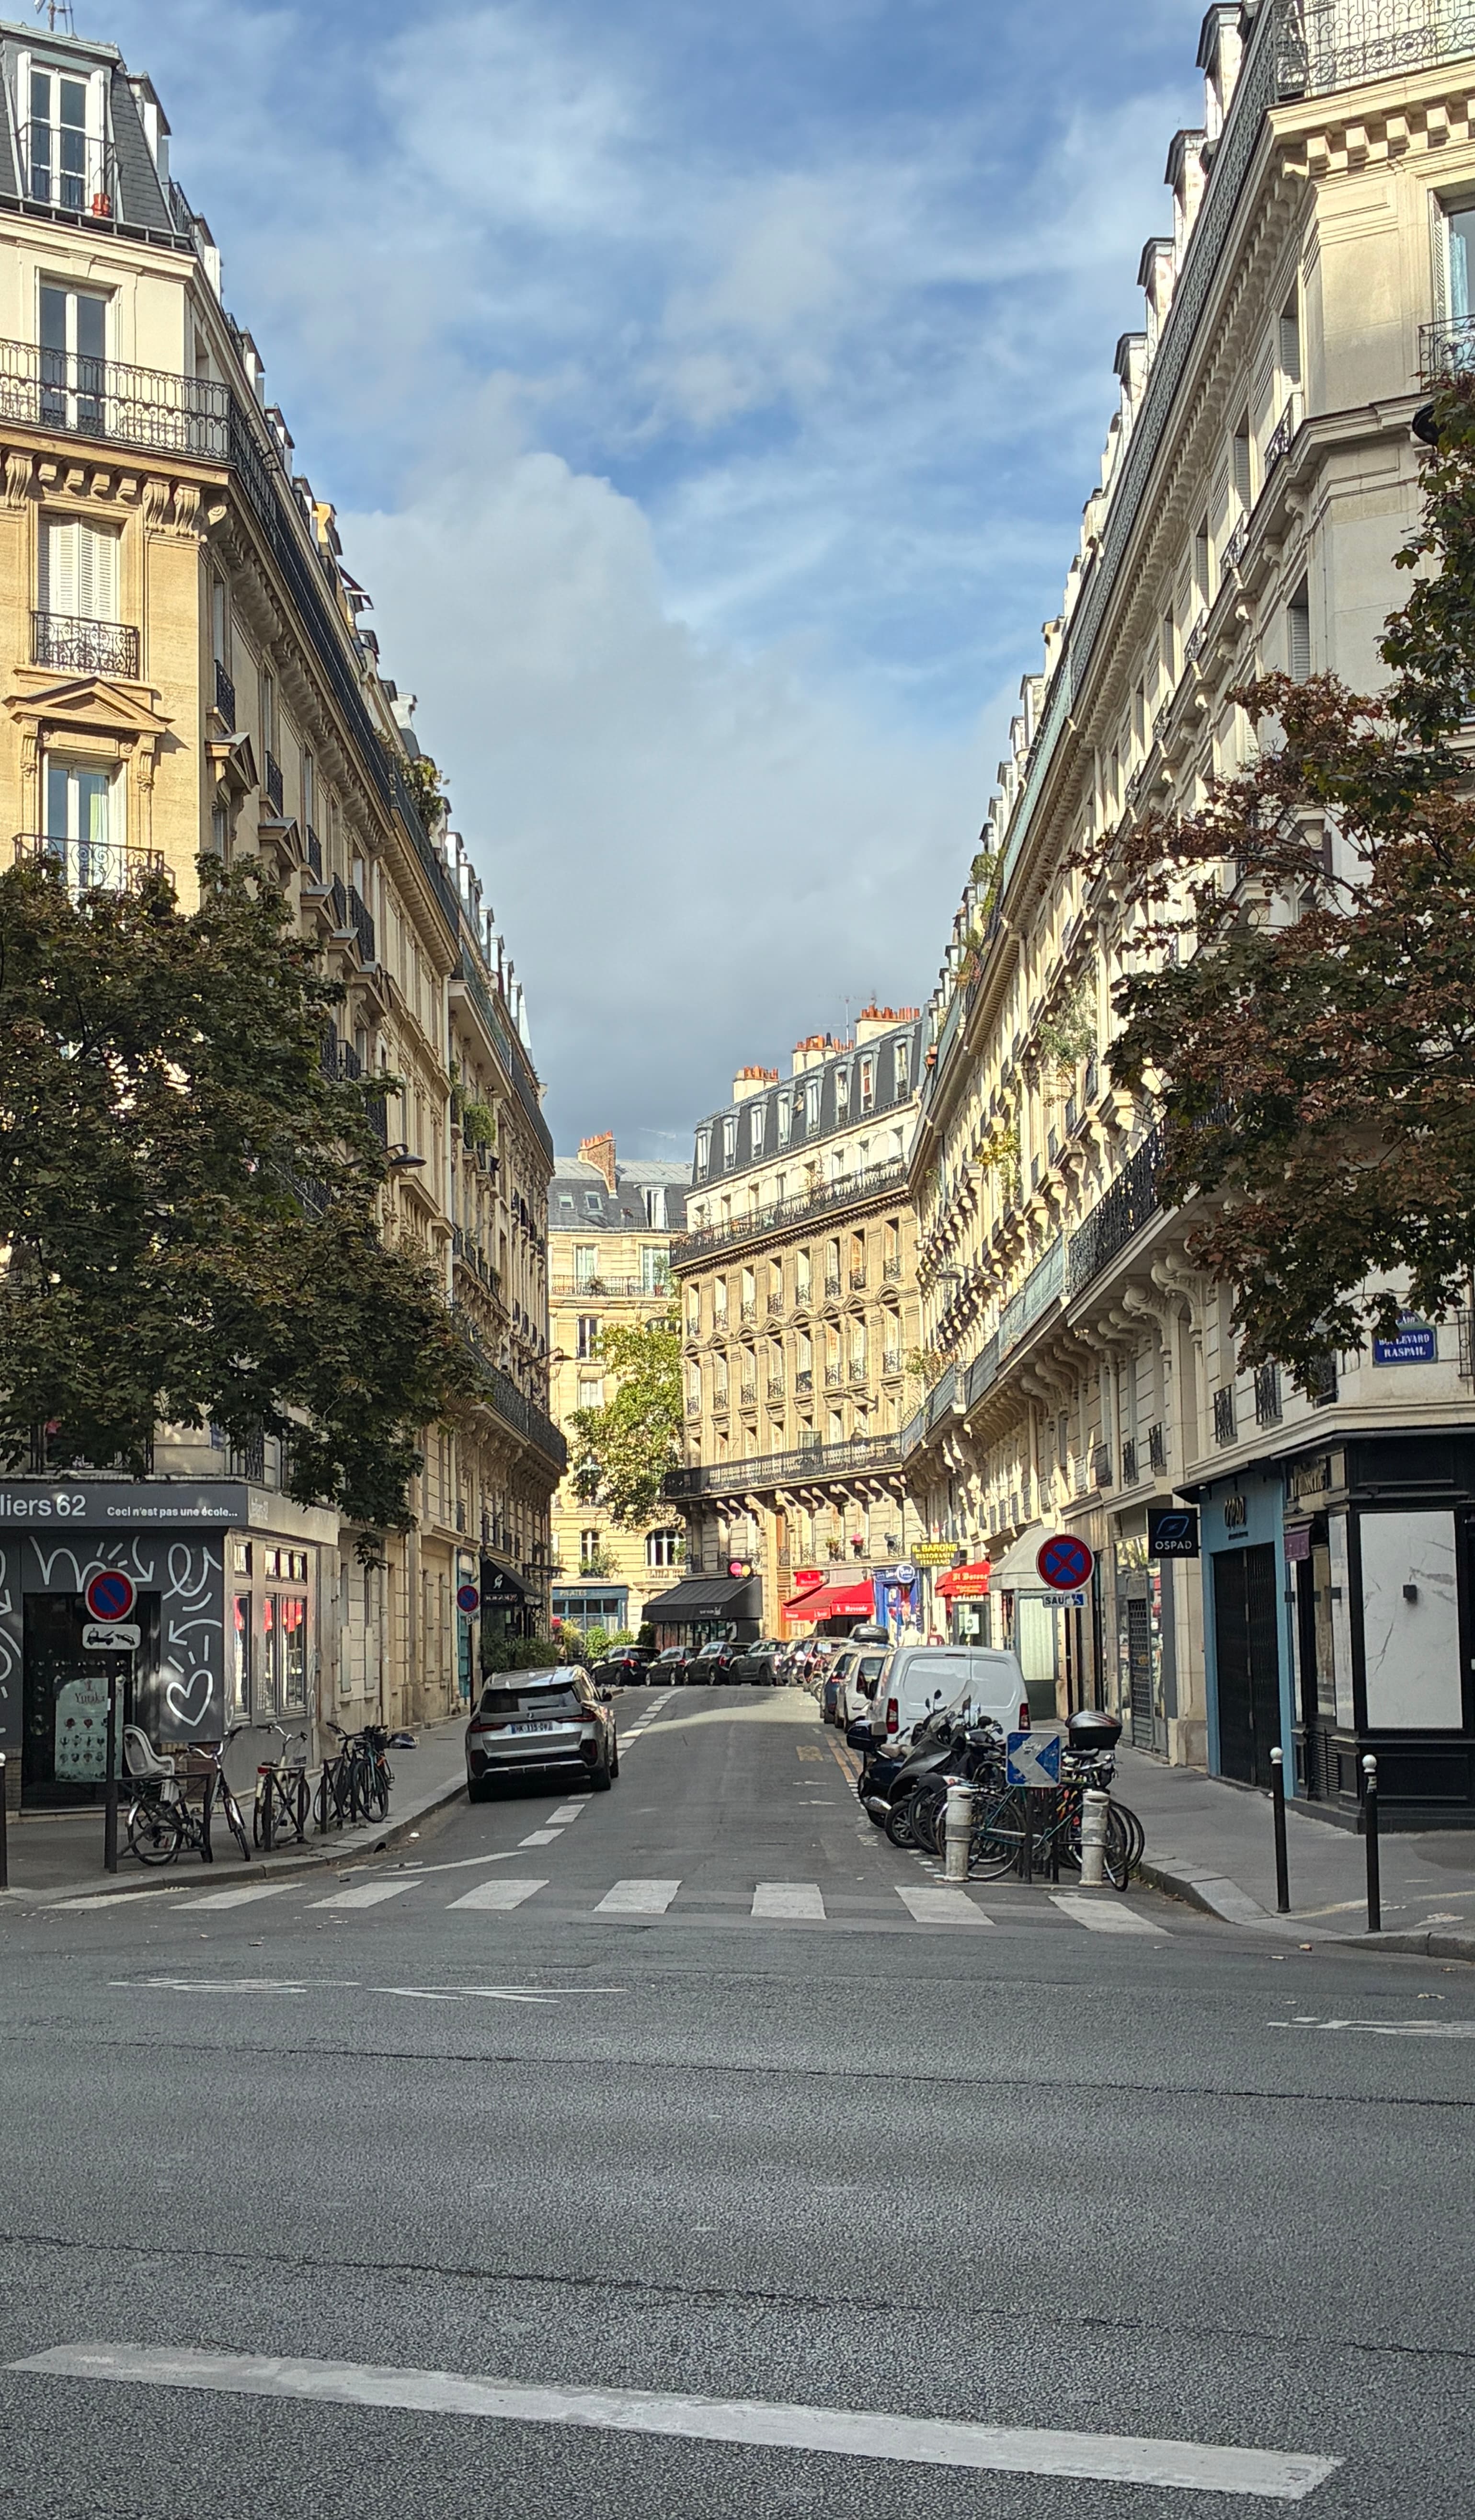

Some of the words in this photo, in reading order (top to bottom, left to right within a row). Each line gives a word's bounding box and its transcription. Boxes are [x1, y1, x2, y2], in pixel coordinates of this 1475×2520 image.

[1384, 1346, 1426, 1358] RASPAIL
[0, 1494, 52, 1516] liers
[56, 1494, 86, 1516] 62
[107, 1506, 130, 1516] Ceci
[132, 1506, 157, 1516] n'est
[160, 1508, 178, 1518] pas
[180, 1508, 200, 1516] une
[921, 1543, 958, 1552] BARONE
[1155, 1540, 1192, 1550] OSPAD
